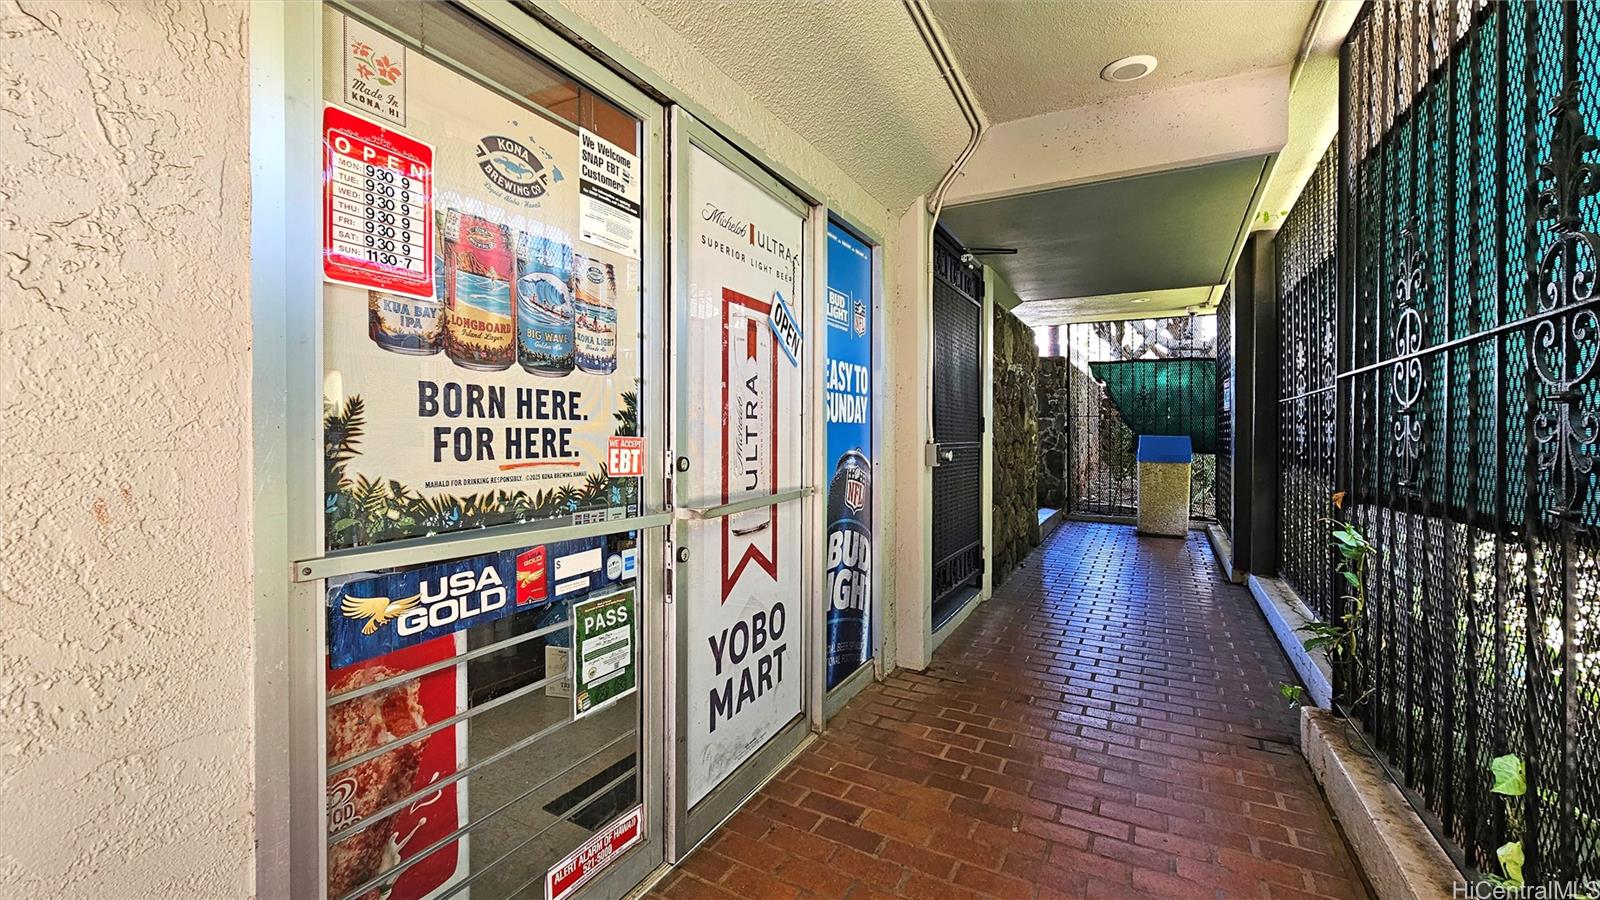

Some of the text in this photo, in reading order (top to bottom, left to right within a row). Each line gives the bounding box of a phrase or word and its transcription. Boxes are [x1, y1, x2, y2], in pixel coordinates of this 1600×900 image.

[352, 78, 383, 101] Made
[389, 107, 399, 117] HI
[335, 137, 424, 179] OPEN
[497, 137, 530, 163] KONA
[582, 134, 631, 169] We Welcome
[582, 149, 620, 177] SNAP EBT
[402, 178, 410, 190] 9
[484, 164, 530, 197] BREWING
[582, 164, 625, 194] Customers
[401, 191, 410, 203] 9
[401, 204, 410, 216] 9
[402, 217, 410, 230] 9
[402, 230, 410, 243] 9
[702, 202, 747, 237] Michelob
[757, 230, 793, 263] ULTRA
[402, 243, 410, 256] 9
[701, 235, 745, 262] SUPERIOR
[751, 258, 772, 274] LIGHT
[383, 299, 438, 320] KUA BAY
[827, 303, 848, 322] LIGHT
[830, 291, 845, 308] BUD
[400, 315, 423, 330] IPA
[452, 317, 512, 334] LONGBOARD
[527, 328, 569, 343] BIG WAVE
[774, 302, 800, 357] OPEN
[596, 337, 615, 346] LIGHT
[854, 365, 868, 394] TO
[418, 380, 588, 421] BORN HERE.
[433, 427, 579, 463] FOR HERE.
[620, 440, 641, 448] ACCEPT
[745, 375, 758, 491] ULTRA
[610, 448, 640, 473] EBT
[451, 479, 462, 487] FOR
[463, 477, 490, 486] DRINKING
[847, 481, 864, 507] NFL
[523, 555, 542, 567] GOLD
[827, 529, 870, 574] BUD
[420, 566, 503, 604] USA
[397, 586, 506, 636] GOLD
[585, 606, 628, 634] PASS
[708, 602, 786, 676] YOBO
[709, 643, 787, 734] MART
[555, 860, 578, 885] ALERT
[579, 840, 603, 867] ALARM
[604, 832, 614, 846] OF
